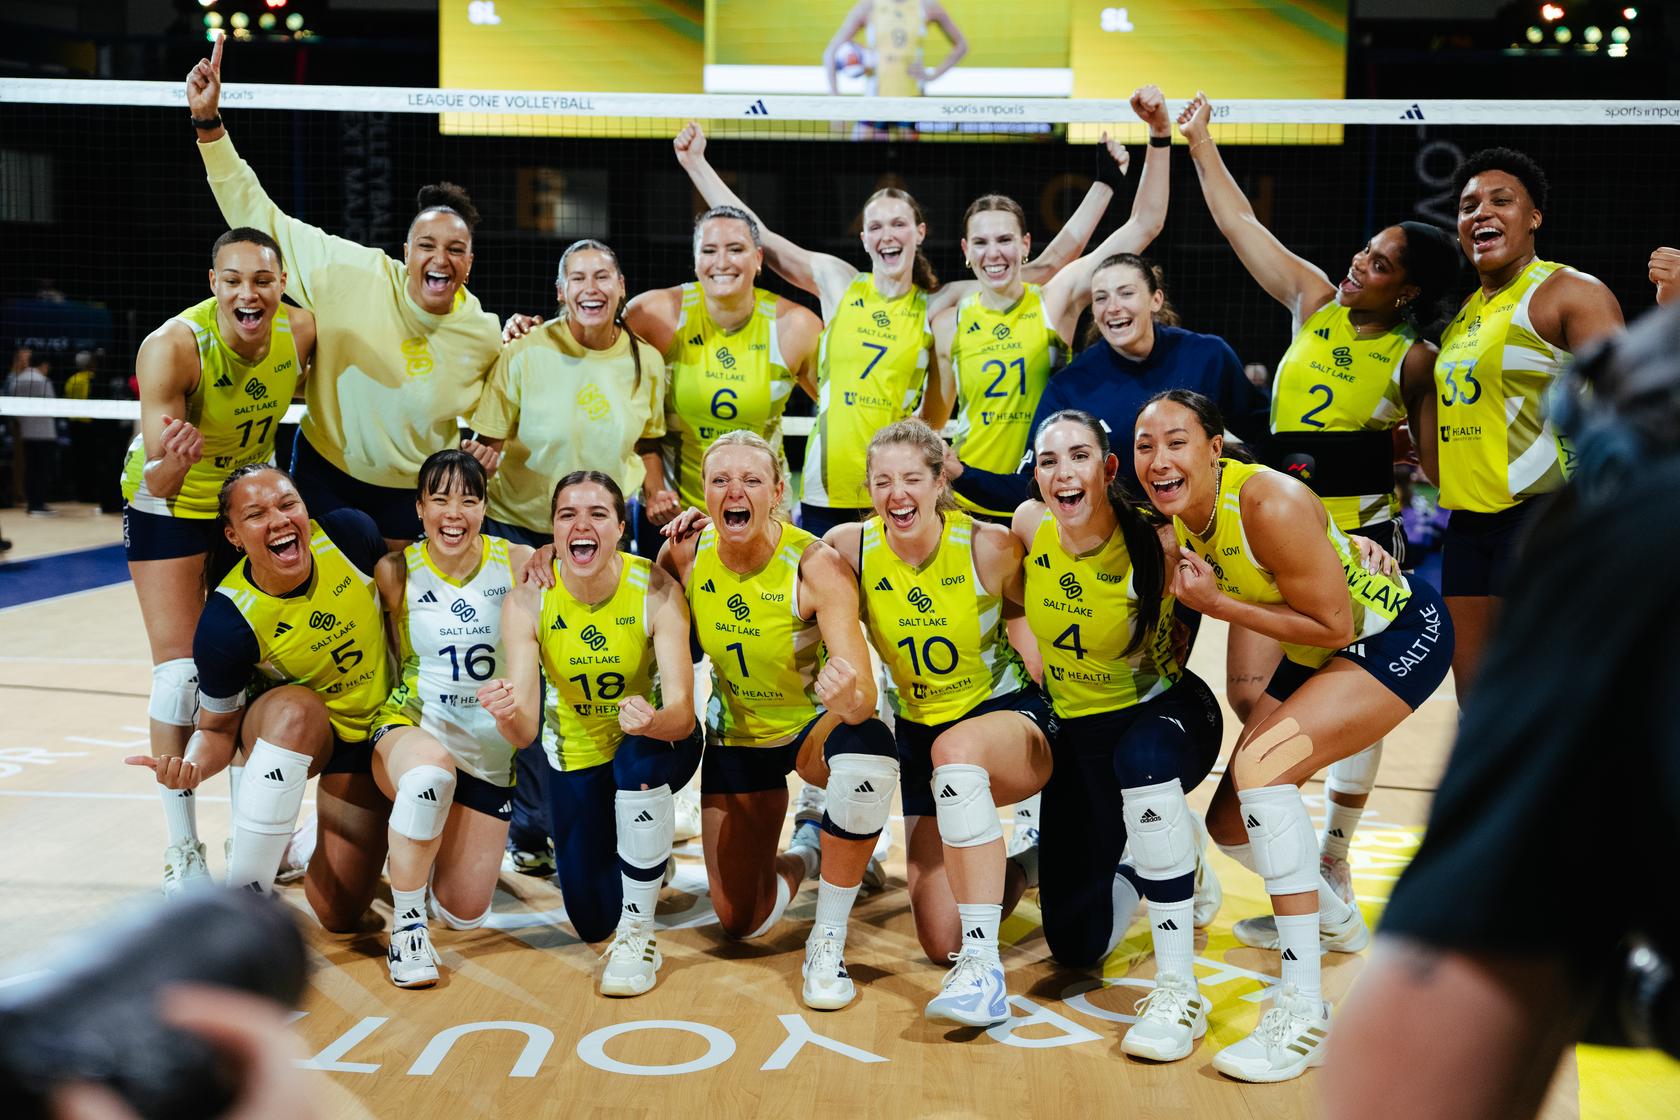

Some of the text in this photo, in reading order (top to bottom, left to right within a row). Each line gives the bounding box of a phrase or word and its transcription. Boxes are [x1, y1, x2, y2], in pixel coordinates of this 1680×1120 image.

[408, 94, 595, 110] LEAGUE ONE VOLLEYBALL
[1604, 106, 1642, 118] sports
[857, 327, 897, 341] SALT LAKE
[1001, 342, 1023, 350] LAKE
[860, 342, 888, 379] 7
[705, 371, 745, 382] SALT LAKE
[981, 357, 1026, 399] 21
[1310, 360, 1356, 383] SALT LAKE
[1441, 359, 1482, 407] 33
[234, 400, 278, 416] SALT LAKE
[710, 388, 738, 421] 6
[859, 396, 892, 408] HEALTH
[1300, 384, 1333, 428] 2
[996, 411, 1031, 420] HEALTH
[236, 415, 273, 448] 11
[941, 575, 966, 586] LOVB
[761, 592, 784, 602] LOVB
[1361, 580, 1410, 613] LAK
[1043, 598, 1093, 617] SALT LAKE
[439, 625, 491, 636] SALT LAKE
[715, 622, 760, 636] SALT LAKE
[899, 618, 948, 627] SALT LAKE
[310, 620, 357, 652] SALT LAKE
[1052, 624, 1088, 660] 4
[1389, 603, 1441, 677] SALT LAKE
[331, 639, 363, 674] 5
[438, 643, 496, 681] 16
[569, 656, 621, 665] SALT LAKE
[726, 642, 749, 678] 1
[897, 636, 959, 676] 10
[346, 670, 375, 688] HEALT
[1068, 672, 1111, 681] HEALTH
[569, 672, 625, 701] 18
[742, 689, 783, 698] HEALTH
[930, 677, 972, 695] HEALTH
[460, 695, 480, 704] HEA
[595, 705, 620, 714] HEA
